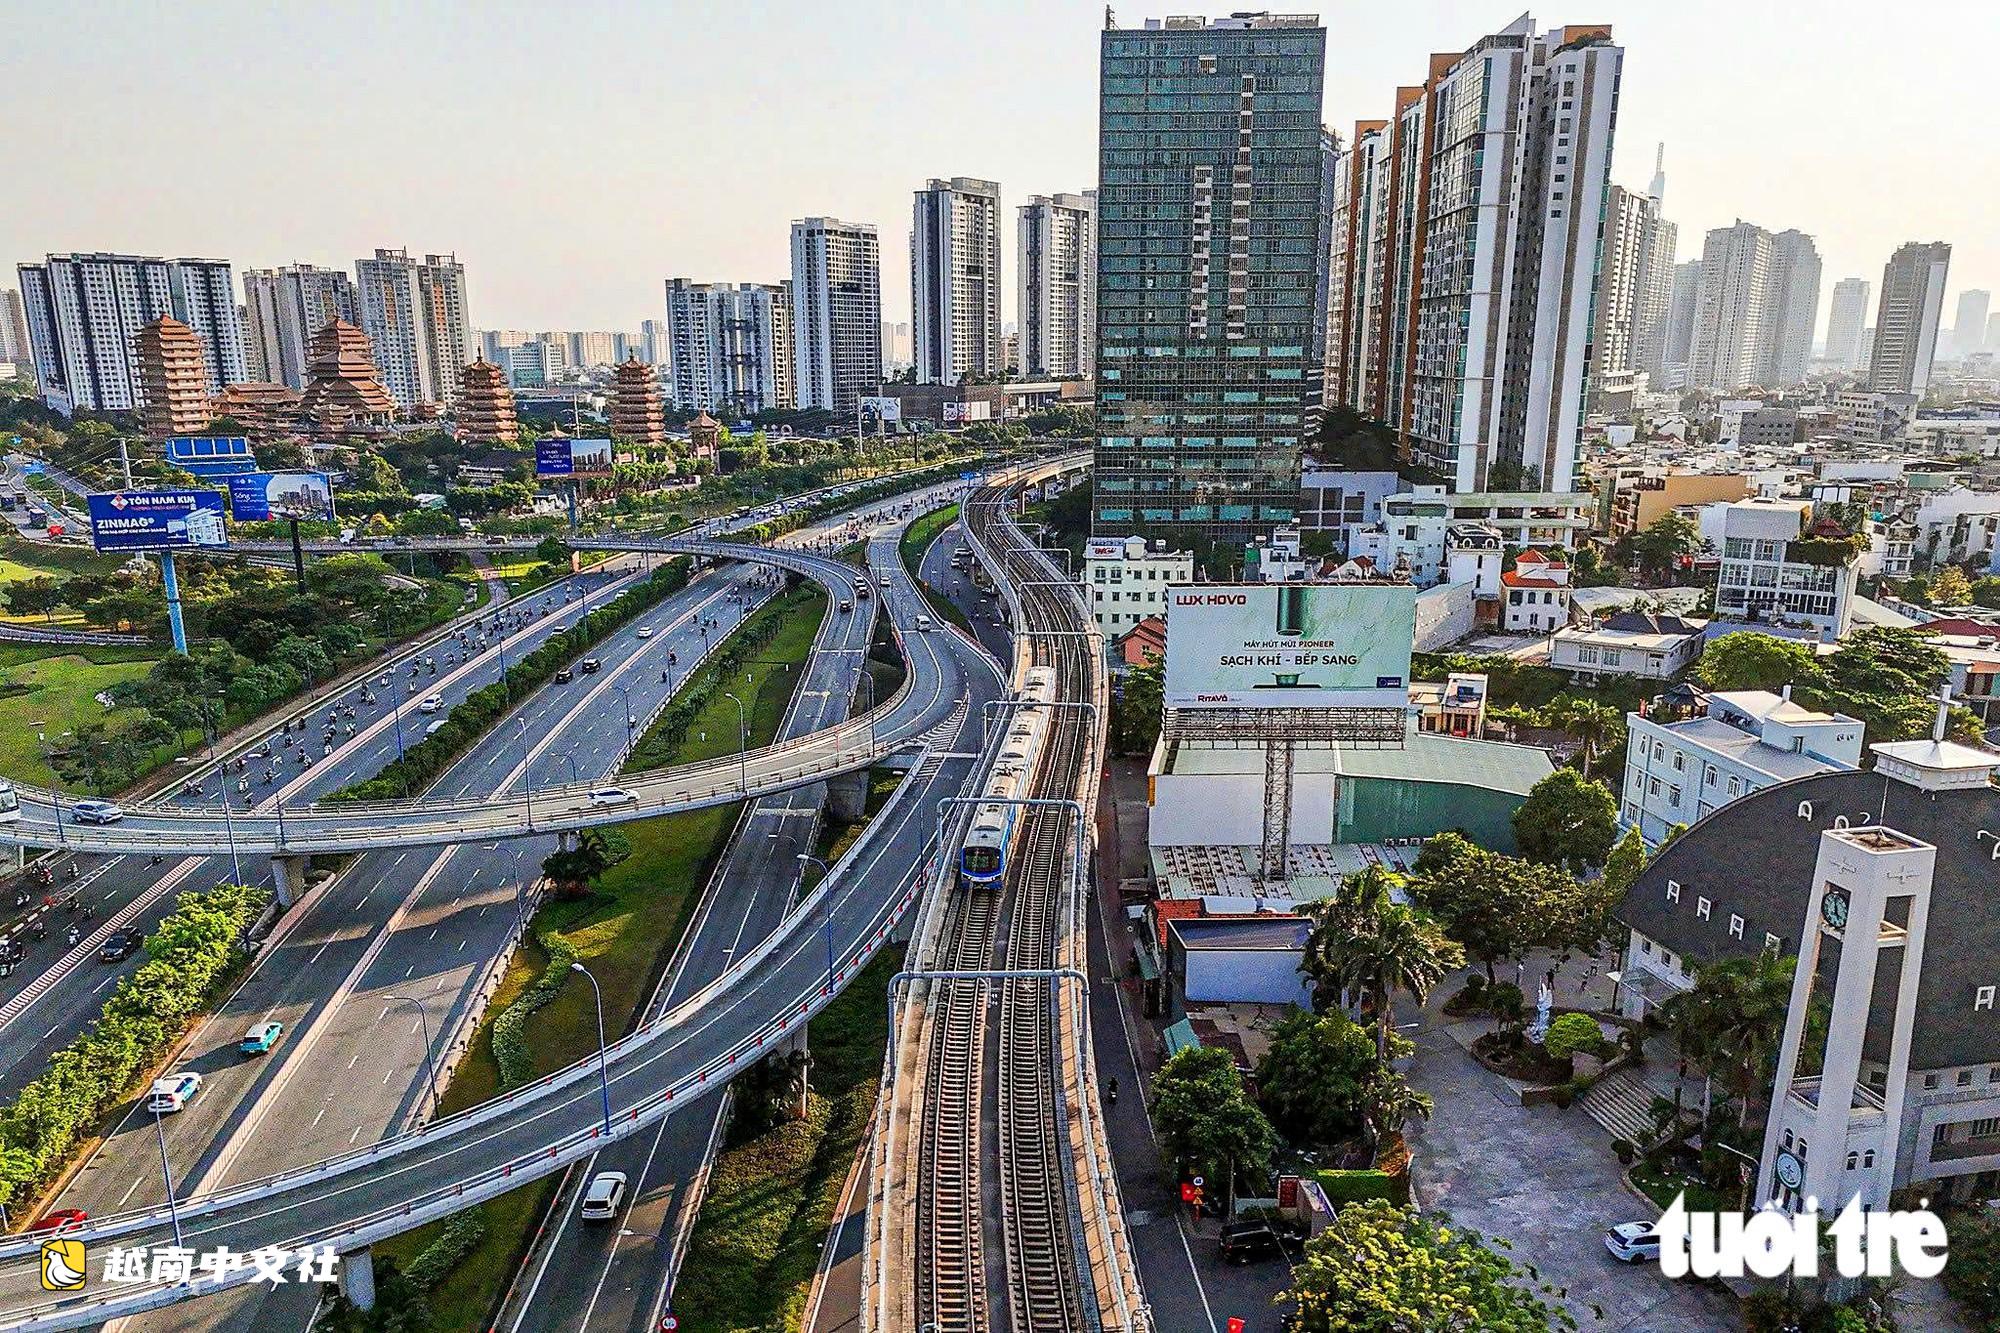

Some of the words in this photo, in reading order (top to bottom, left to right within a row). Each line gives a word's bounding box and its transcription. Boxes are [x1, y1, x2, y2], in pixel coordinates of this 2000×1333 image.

[128, 496, 149, 505] TÔN
[152, 496, 174, 505] NAM
[178, 495, 196, 504] KIM
[1176, 595, 1203, 605] LUX
[1207, 594, 1247, 605] HOVO
[1244, 640, 1260, 648] MÁY
[1262, 640, 1279, 648] HÚT
[1280, 640, 1297, 648] MÙI
[1298, 640, 1335, 648] PIONEER
[1220, 655, 1253, 668] SẠCH
[1257, 652, 1282, 666] KHÍ
[1295, 651, 1319, 665] BẾP
[1321, 655, 1358, 665] SANG
